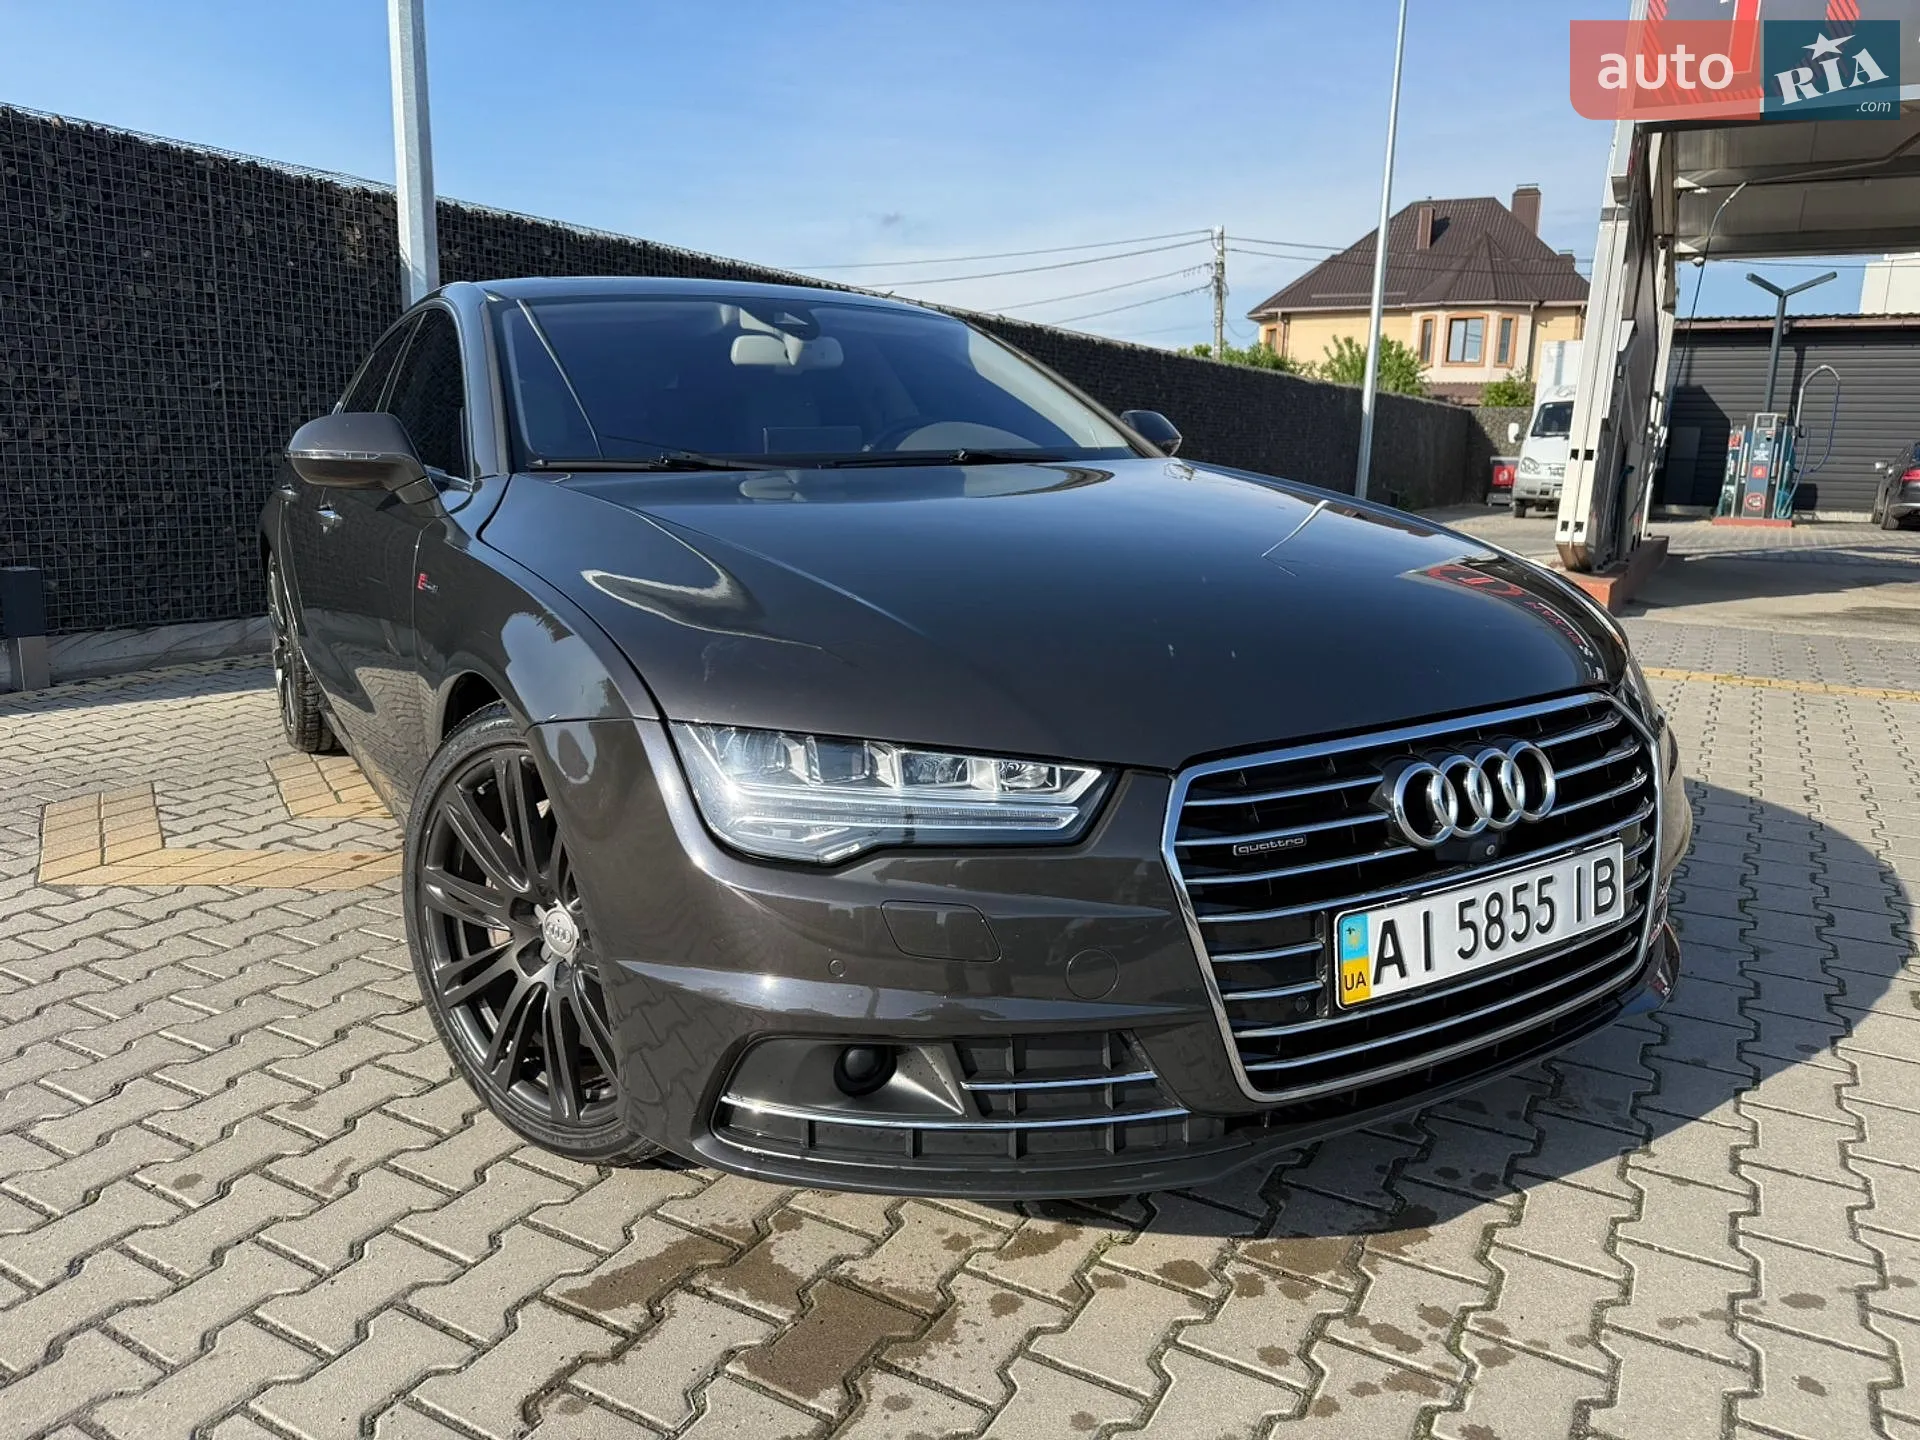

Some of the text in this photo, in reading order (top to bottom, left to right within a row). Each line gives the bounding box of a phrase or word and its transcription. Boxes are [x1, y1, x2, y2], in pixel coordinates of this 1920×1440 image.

[1238, 837, 1304, 854] quattro
[1373, 856, 1618, 986] AI 5855 IB
[1343, 970, 1367, 992] UA
